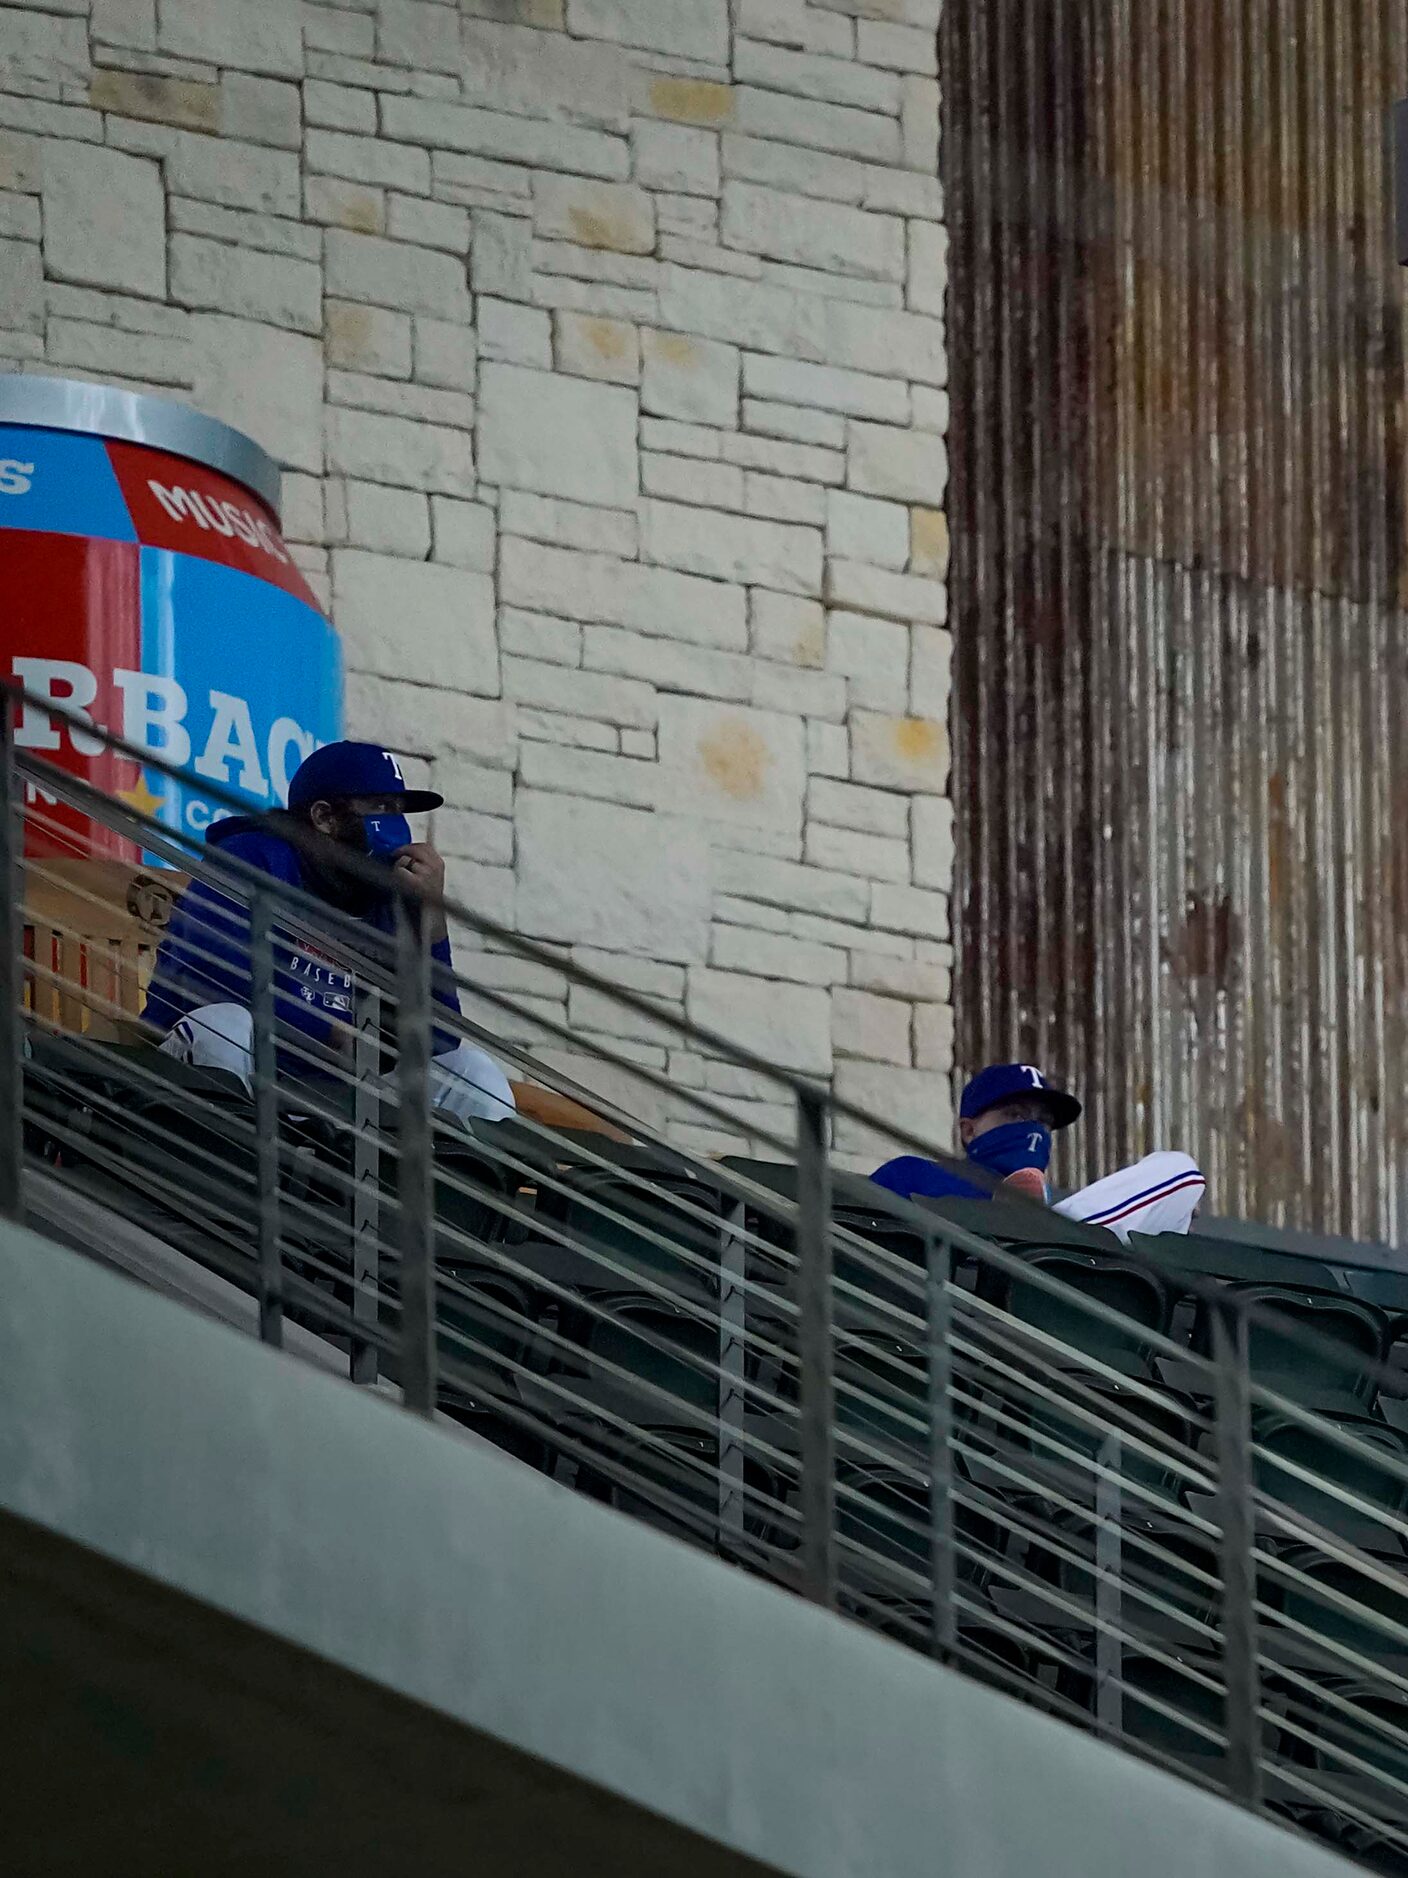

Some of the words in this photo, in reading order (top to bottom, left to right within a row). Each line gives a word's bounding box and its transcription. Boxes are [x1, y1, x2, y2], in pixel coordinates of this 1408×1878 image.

[12, 656, 332, 812] RBAC
[370, 820, 381, 832] T
[1020, 1065, 1044, 1089] T
[1026, 1132, 1043, 1153] T
